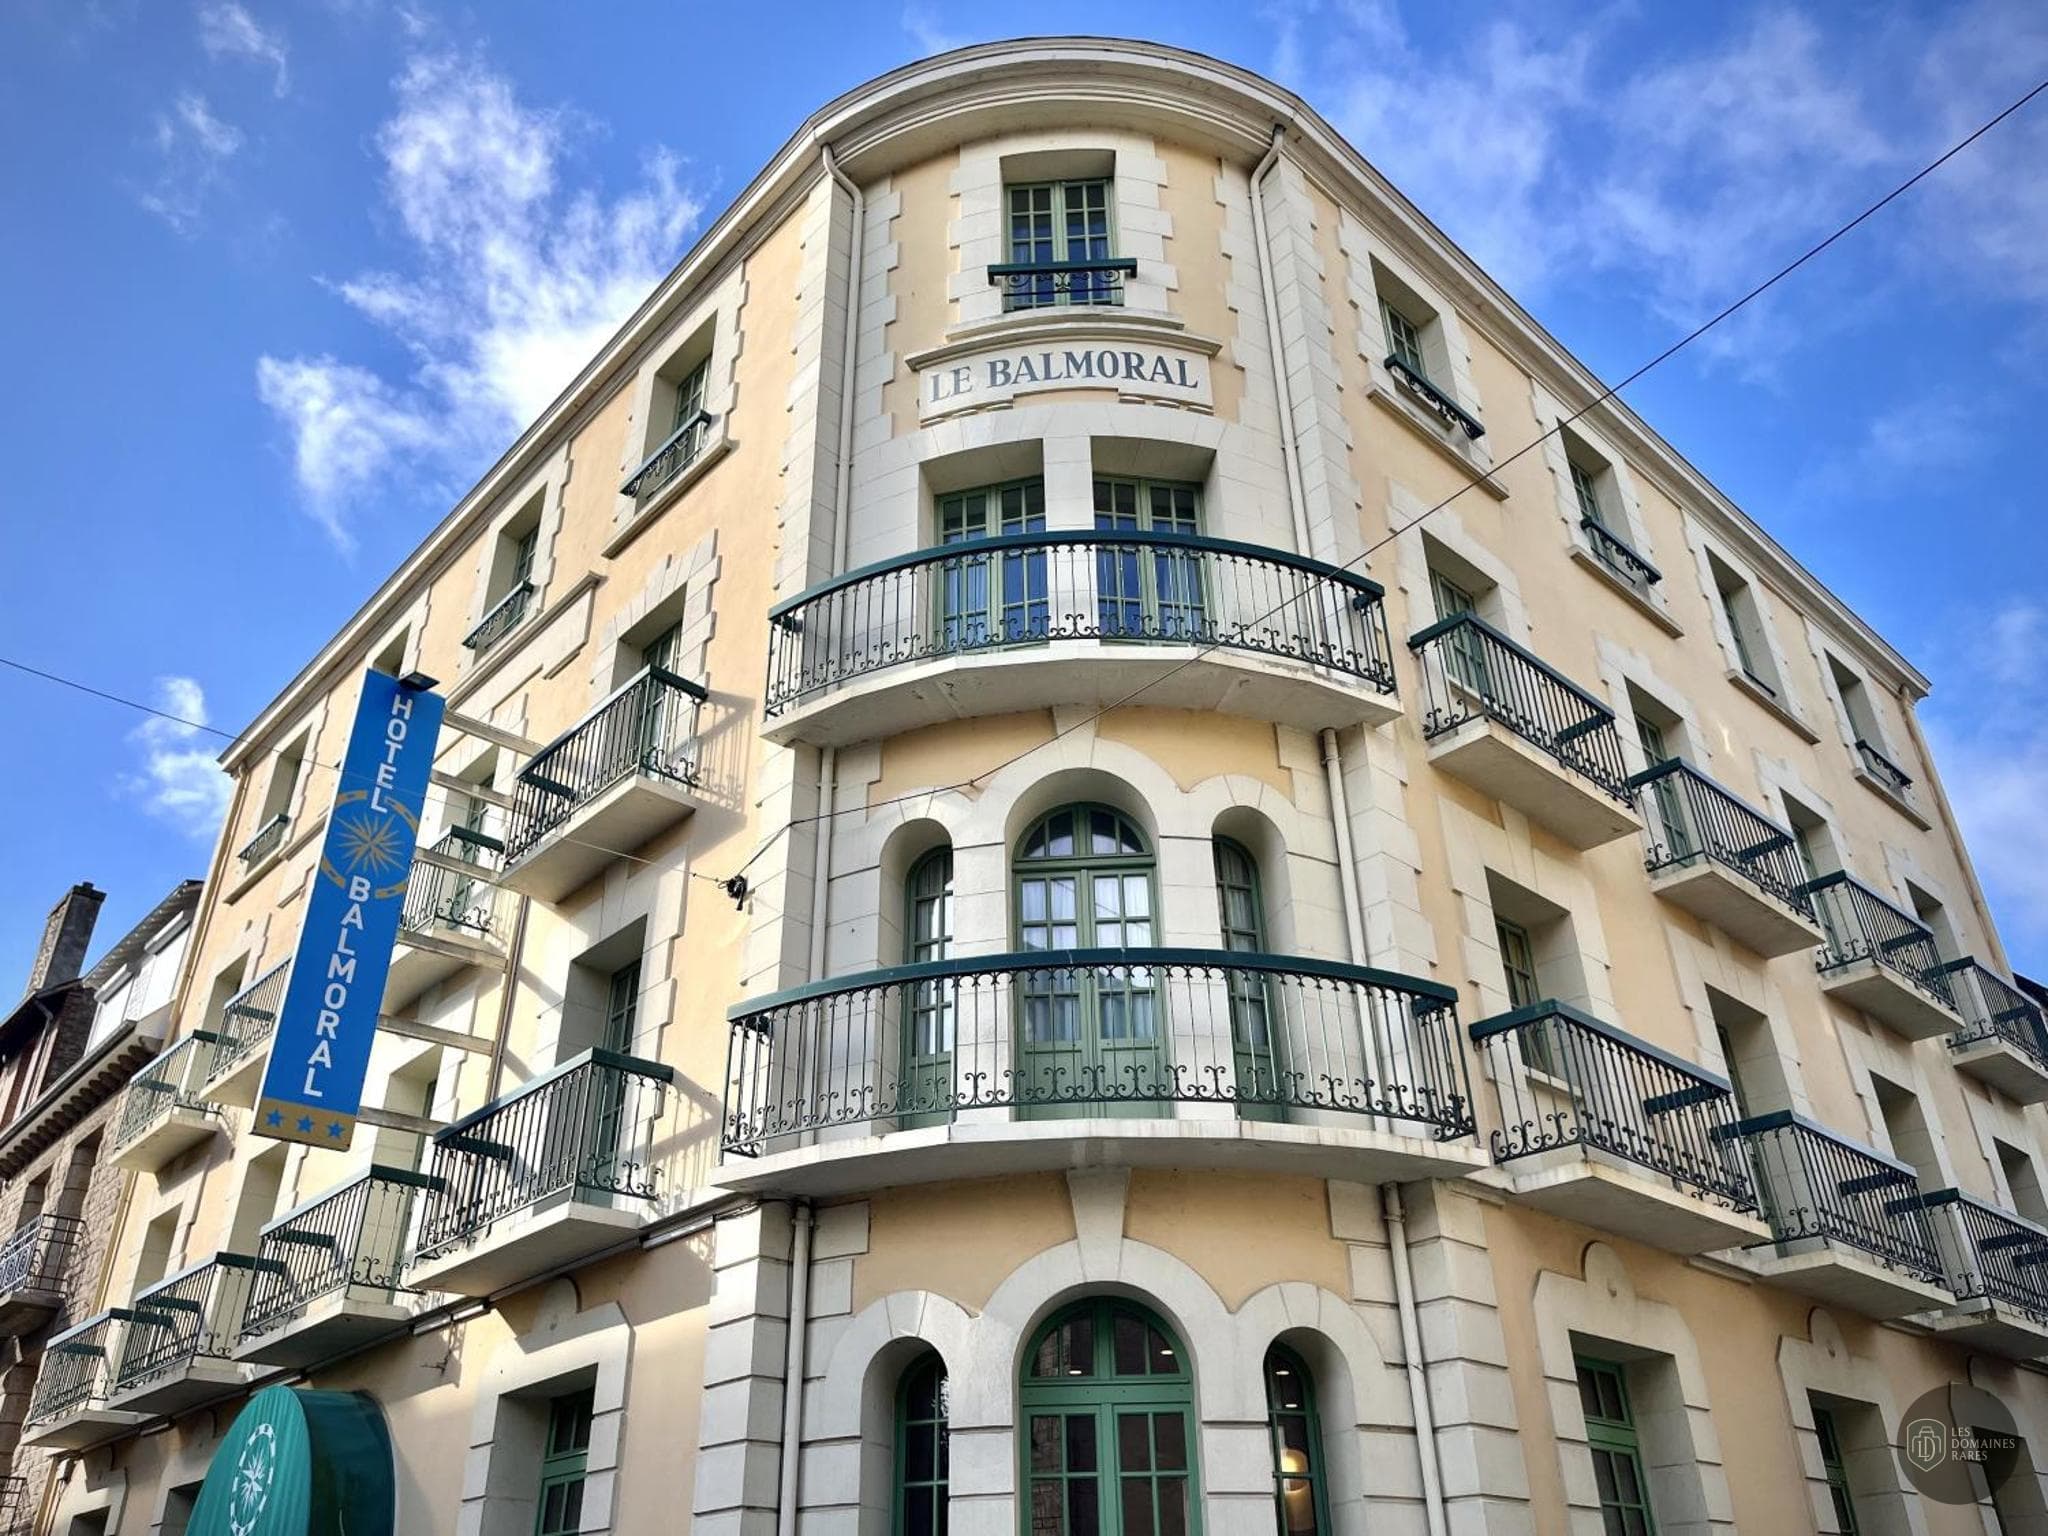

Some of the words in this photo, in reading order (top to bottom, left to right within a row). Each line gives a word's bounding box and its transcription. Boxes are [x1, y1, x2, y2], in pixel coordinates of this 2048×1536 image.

[930, 366, 973, 403] LE
[986, 350, 1200, 388] BALMORAL
[370, 693, 413, 815] HOTEL
[303, 875, 371, 1098] BALMORAL
